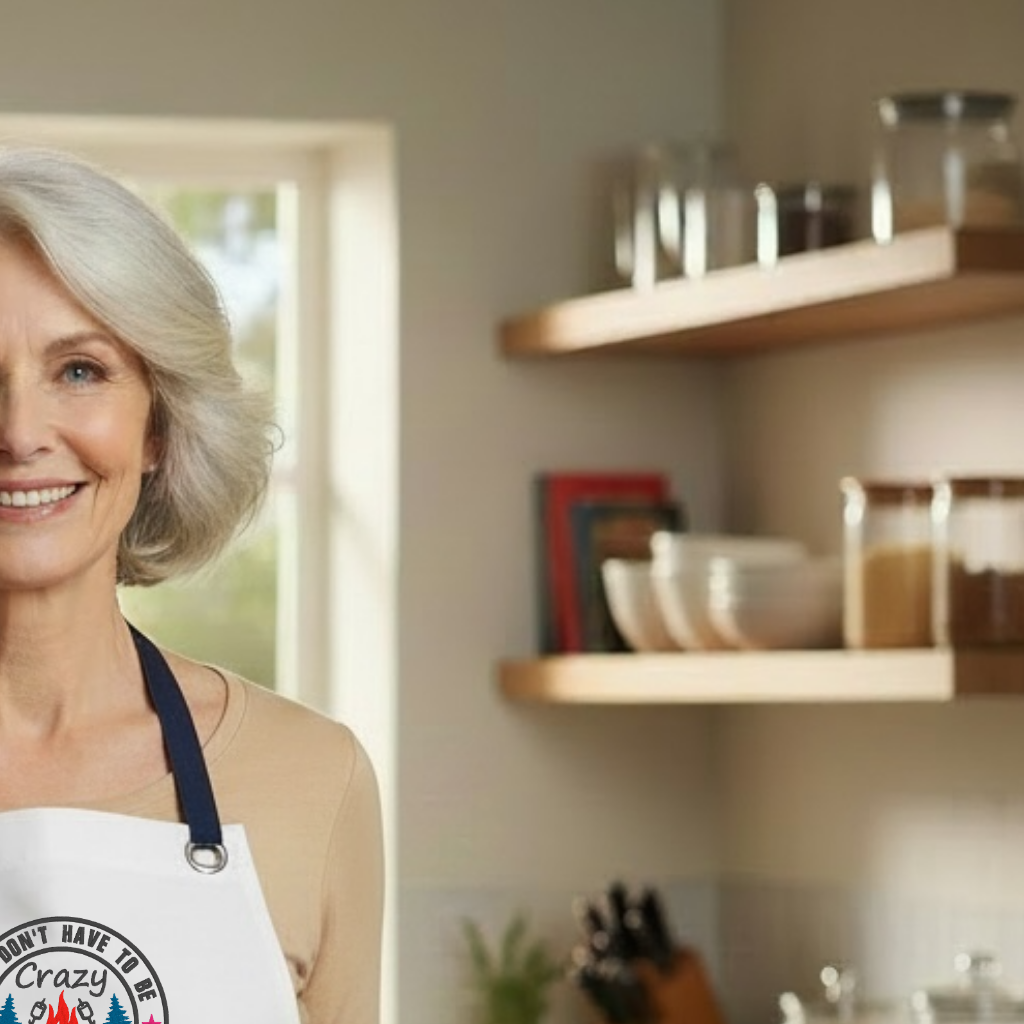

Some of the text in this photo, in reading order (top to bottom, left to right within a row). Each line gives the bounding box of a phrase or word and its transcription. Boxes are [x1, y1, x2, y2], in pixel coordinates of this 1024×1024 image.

[15, 961, 108, 998] Crazy
[61, 924, 111, 954] HAVE
[115, 947, 140, 974] TO
[133, 977, 158, 1003] BE
